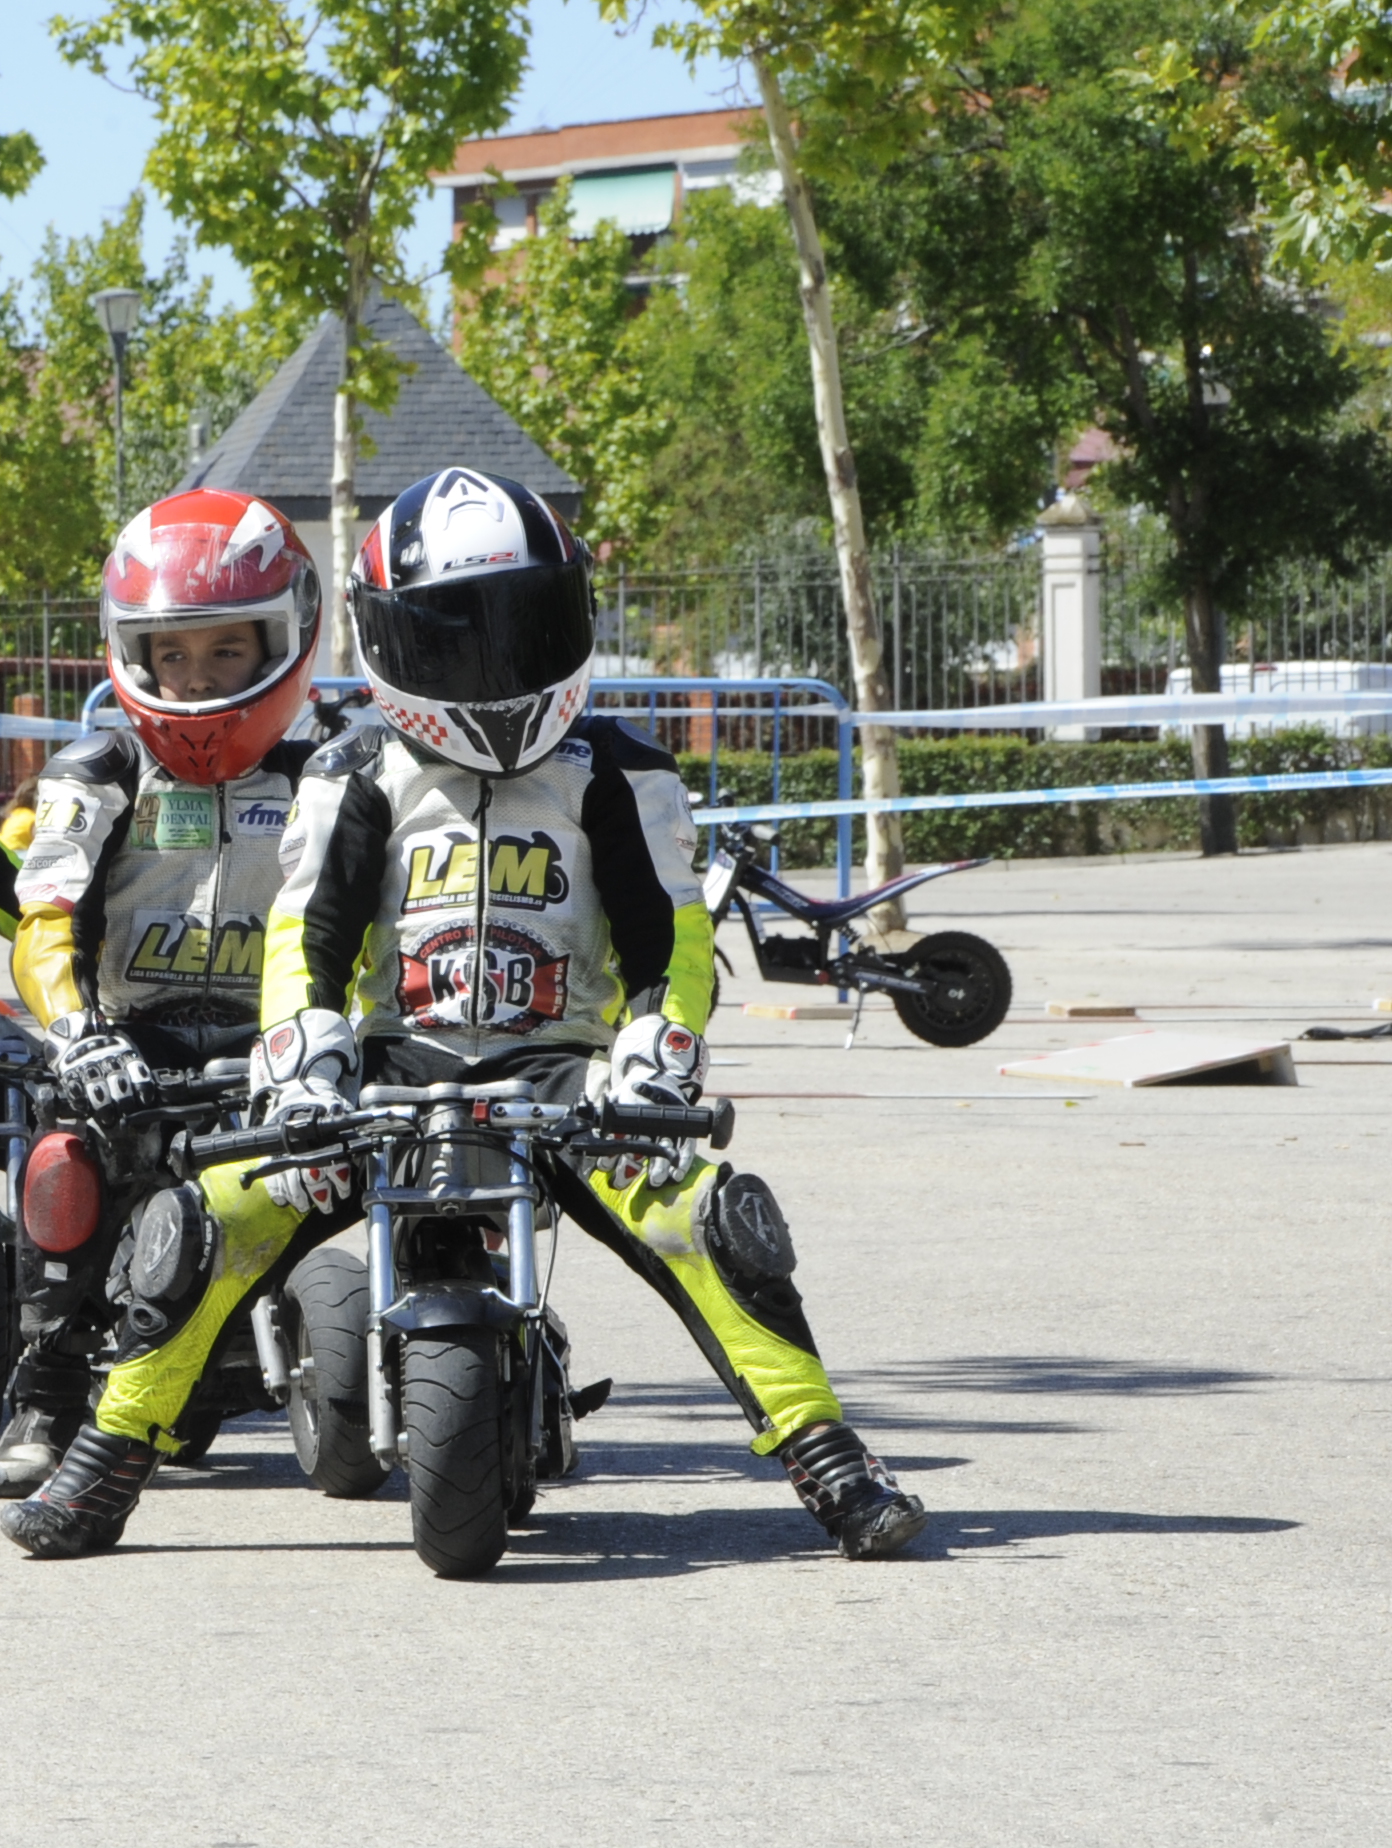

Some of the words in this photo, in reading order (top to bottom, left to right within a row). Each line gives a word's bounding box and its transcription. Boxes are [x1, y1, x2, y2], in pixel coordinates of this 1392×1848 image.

[441, 551, 519, 573] LS2
[161, 813, 212, 826] DENTAL
[168, 800, 204, 812] YLMA
[407, 843, 550, 900] LEM
[133, 926, 263, 975] LEM
[419, 929, 462, 960] CENTRO
[490, 928, 544, 960] PILOTAJE
[430, 948, 535, 1021] KSB
[552, 963, 565, 1015] SPORT
